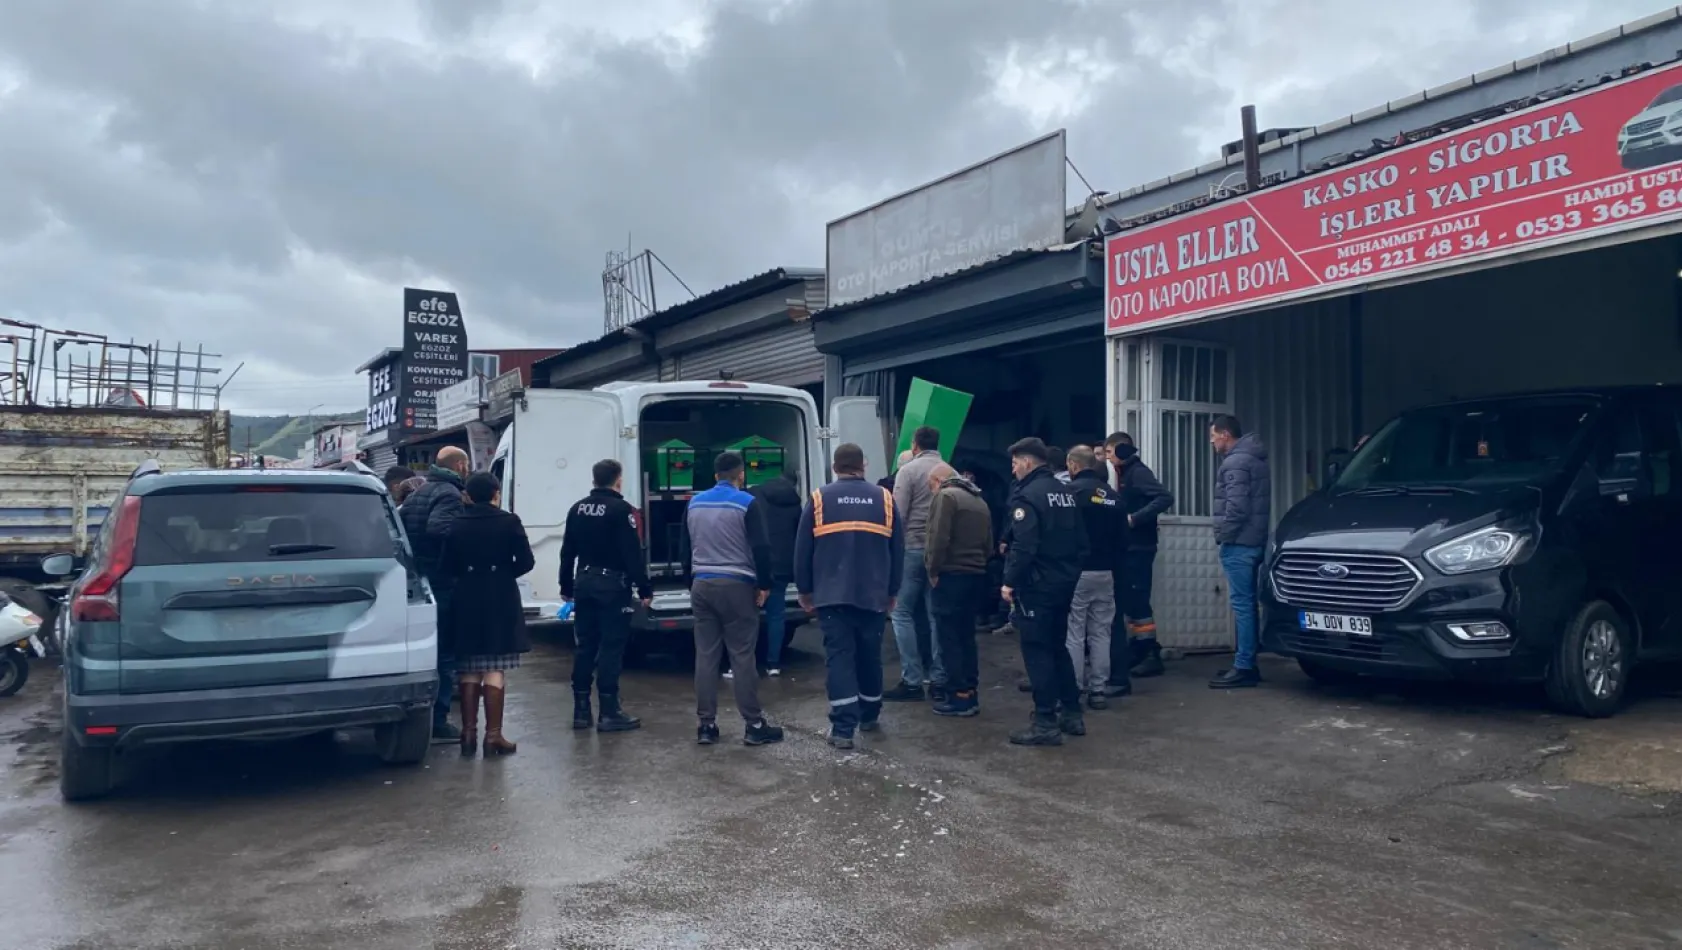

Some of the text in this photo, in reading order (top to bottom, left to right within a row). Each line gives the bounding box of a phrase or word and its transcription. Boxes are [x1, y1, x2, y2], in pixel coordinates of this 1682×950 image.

[1303, 164, 1399, 209] KASKO
[1428, 111, 1584, 174] SİGORTA
[1320, 154, 1573, 240] İŞLERİ YAPILIR
[1564, 167, 1682, 208] HAMDİ UST
[1114, 241, 1171, 286] USTA
[1177, 216, 1260, 272] ELLER
[1325, 256, 1373, 280] 0545
[1379, 247, 1417, 269] 221
[1424, 239, 1453, 259] 48
[1460, 230, 1490, 251] 34
[1515, 210, 1582, 239] 0533
[1592, 195, 1647, 223] 365
[1337, 215, 1481, 260] MUHAMMET ADALI
[837, 275, 865, 291] OTO
[869, 249, 941, 279] KAPORTA
[1110, 257, 1290, 320] OTO KAPORTA BOYA
[408, 311, 459, 327] EGZOZ
[419, 297, 448, 312] efe
[414, 332, 458, 344] VAREX
[421, 344, 451, 352] EGZOZ
[372, 364, 391, 397] EFE
[407, 366, 463, 377] KONVEKTÖR
[366, 396, 397, 433] EGZOZ
[227, 573, 316, 585] DACIA
[1305, 613, 1319, 628] 34
[1349, 617, 1371, 632] 839
